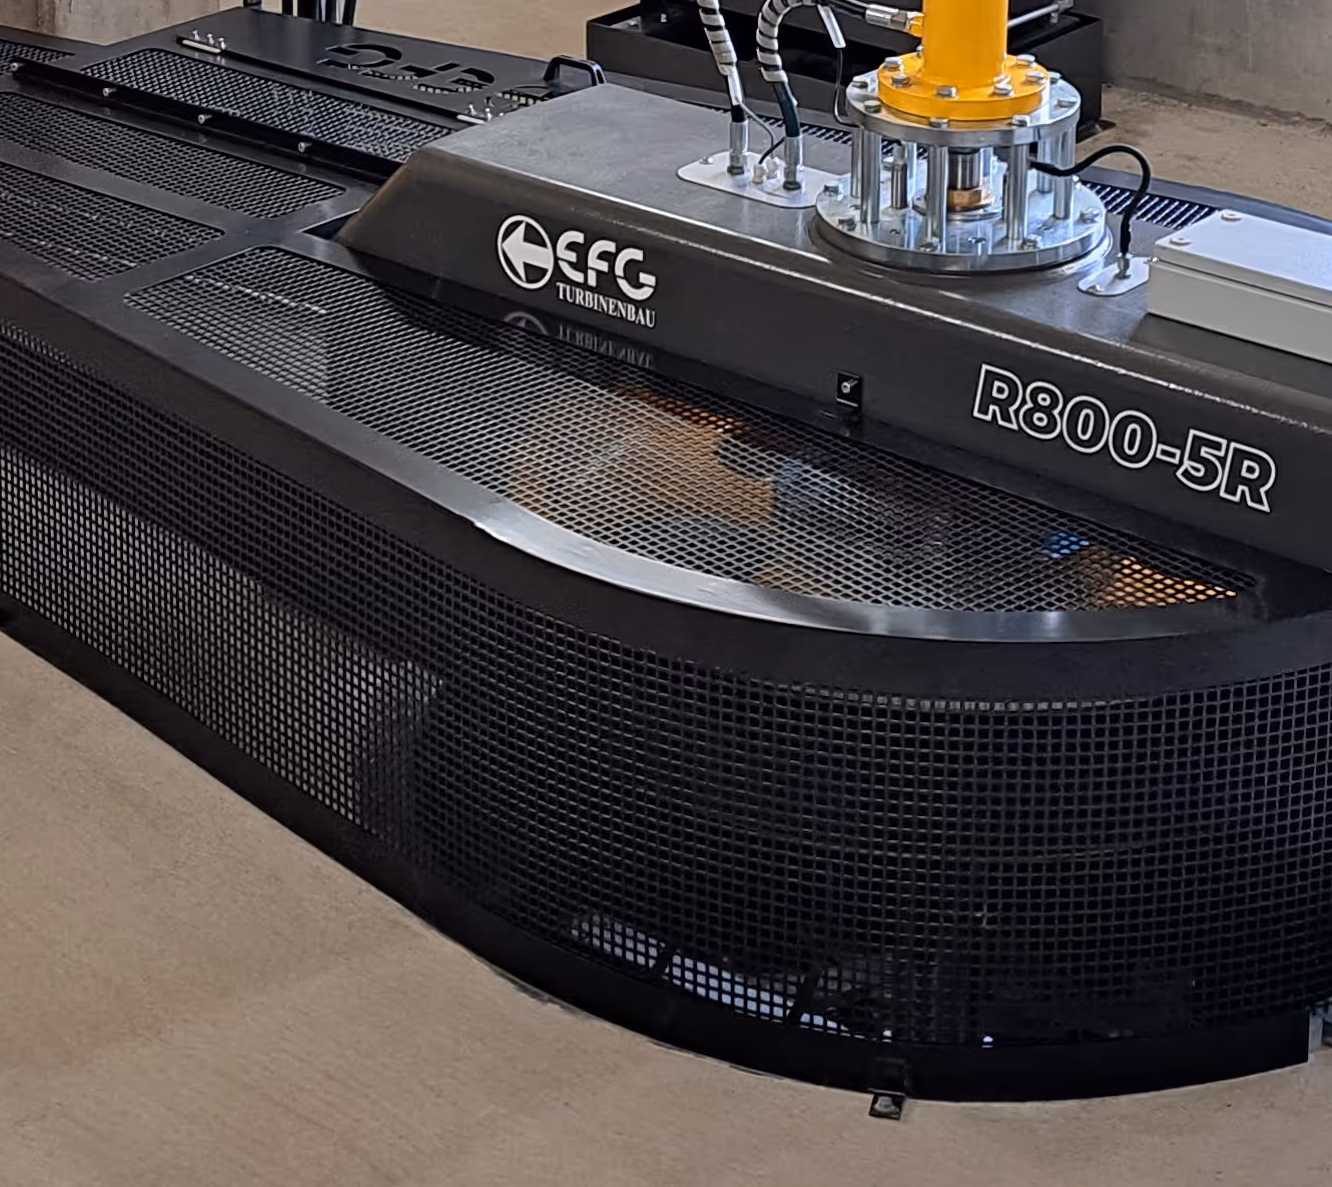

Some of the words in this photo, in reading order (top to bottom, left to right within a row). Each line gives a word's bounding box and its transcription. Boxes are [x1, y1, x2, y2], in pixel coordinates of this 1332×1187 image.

[555, 230, 657, 302] EFG
[555, 282, 657, 329] TURBINENBAU
[972, 363, 1277, 513] R800-5R
